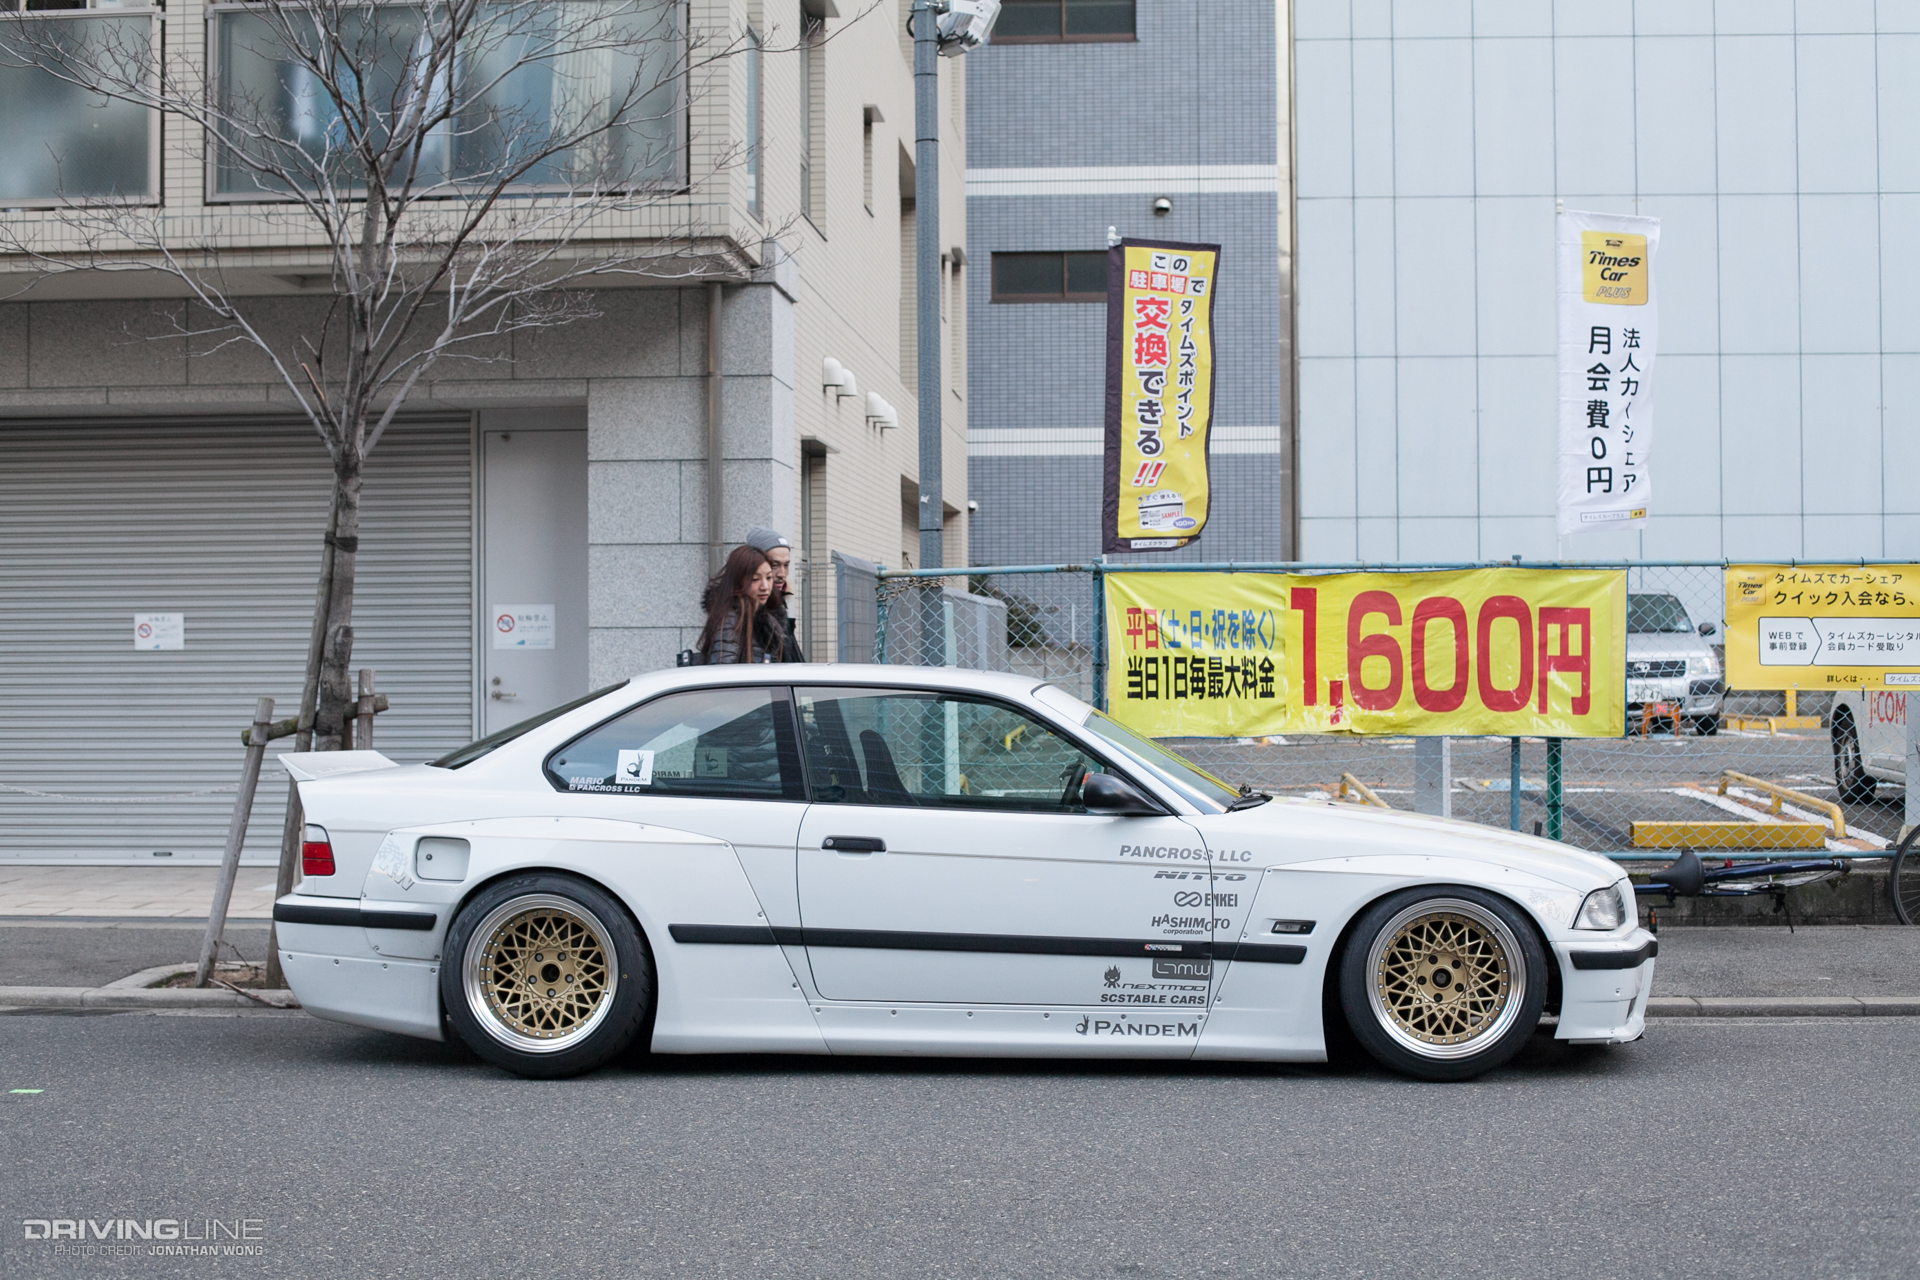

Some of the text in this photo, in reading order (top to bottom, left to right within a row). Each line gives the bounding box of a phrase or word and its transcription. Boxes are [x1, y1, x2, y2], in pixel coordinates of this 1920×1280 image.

[1154, 255, 1188, 272] この
[1589, 250, 1642, 267] Times
[1600, 267, 1628, 282] Car
[1130, 271, 1205, 294] 駐車場で
[1595, 285, 1631, 298] PLUS
[1177, 300, 1196, 437] タイムズポイント
[1161, 511, 1180, 519] SAMPLE
[1775, 573, 1903, 584] タイムズでカーシェア
[1738, 582, 1763, 590] Times
[1774, 591, 1915, 606] クイック入会なら、
[1768, 642, 1808, 651] 事前登録
[1827, 642, 1905, 651] 会員カード受取り
[1291, 587, 1591, 725] 1,600円
[1127, 655, 1275, 700] 当日1日毎最大料金
[1889, 675, 1920, 683] タイムズ
[569, 776, 604, 785] MARIO
[577, 784, 623, 792] PANCROSS
[1119, 845, 1252, 862] PANCROSS LLC
[1153, 870, 1247, 882] NITTO
[1204, 893, 1238, 907] ENKEI
[1151, 913, 1231, 932] HASHIMOTO
[1100, 993, 1206, 1004] SCSTABLE CARS
